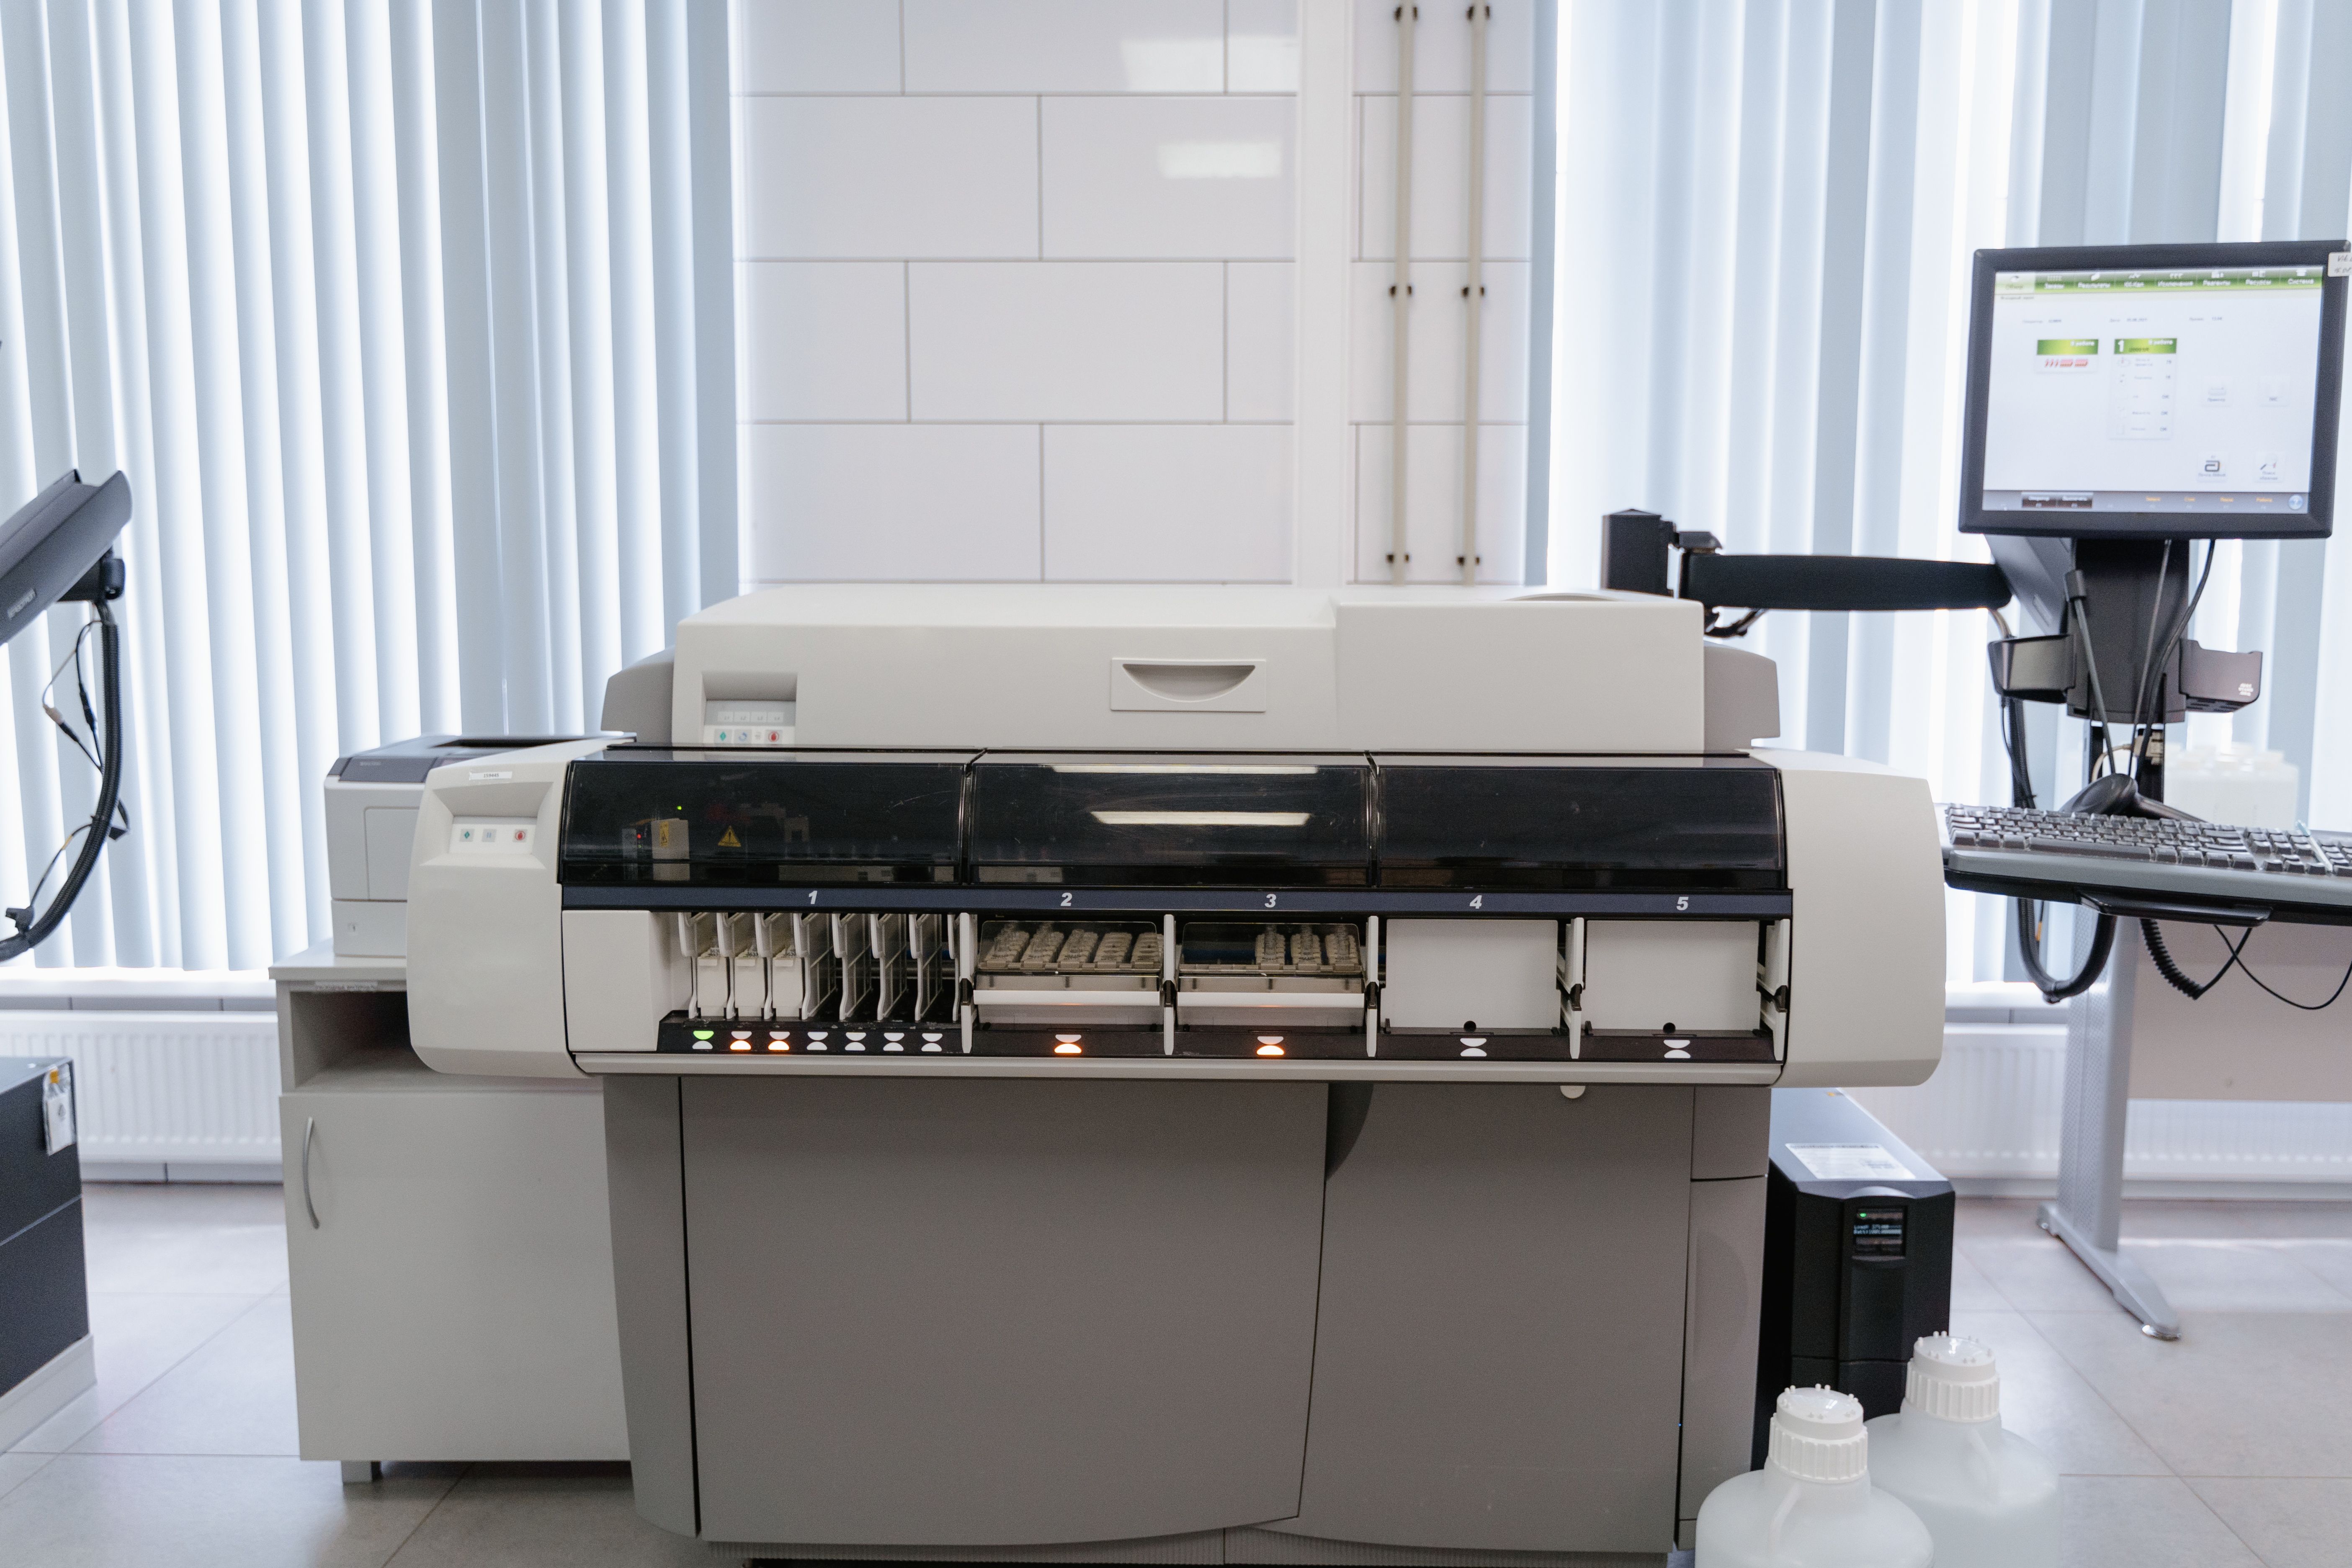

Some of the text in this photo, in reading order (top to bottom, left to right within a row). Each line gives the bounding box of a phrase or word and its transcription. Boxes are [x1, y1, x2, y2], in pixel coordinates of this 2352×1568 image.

[2118, 340, 2124, 353] 1
[809, 891, 817, 904] 1
[1061, 893, 1072, 906] 2
[1265, 894, 1276, 908] 3
[1470, 895, 1482, 909] 4
[1677, 896, 1688, 911] 5
